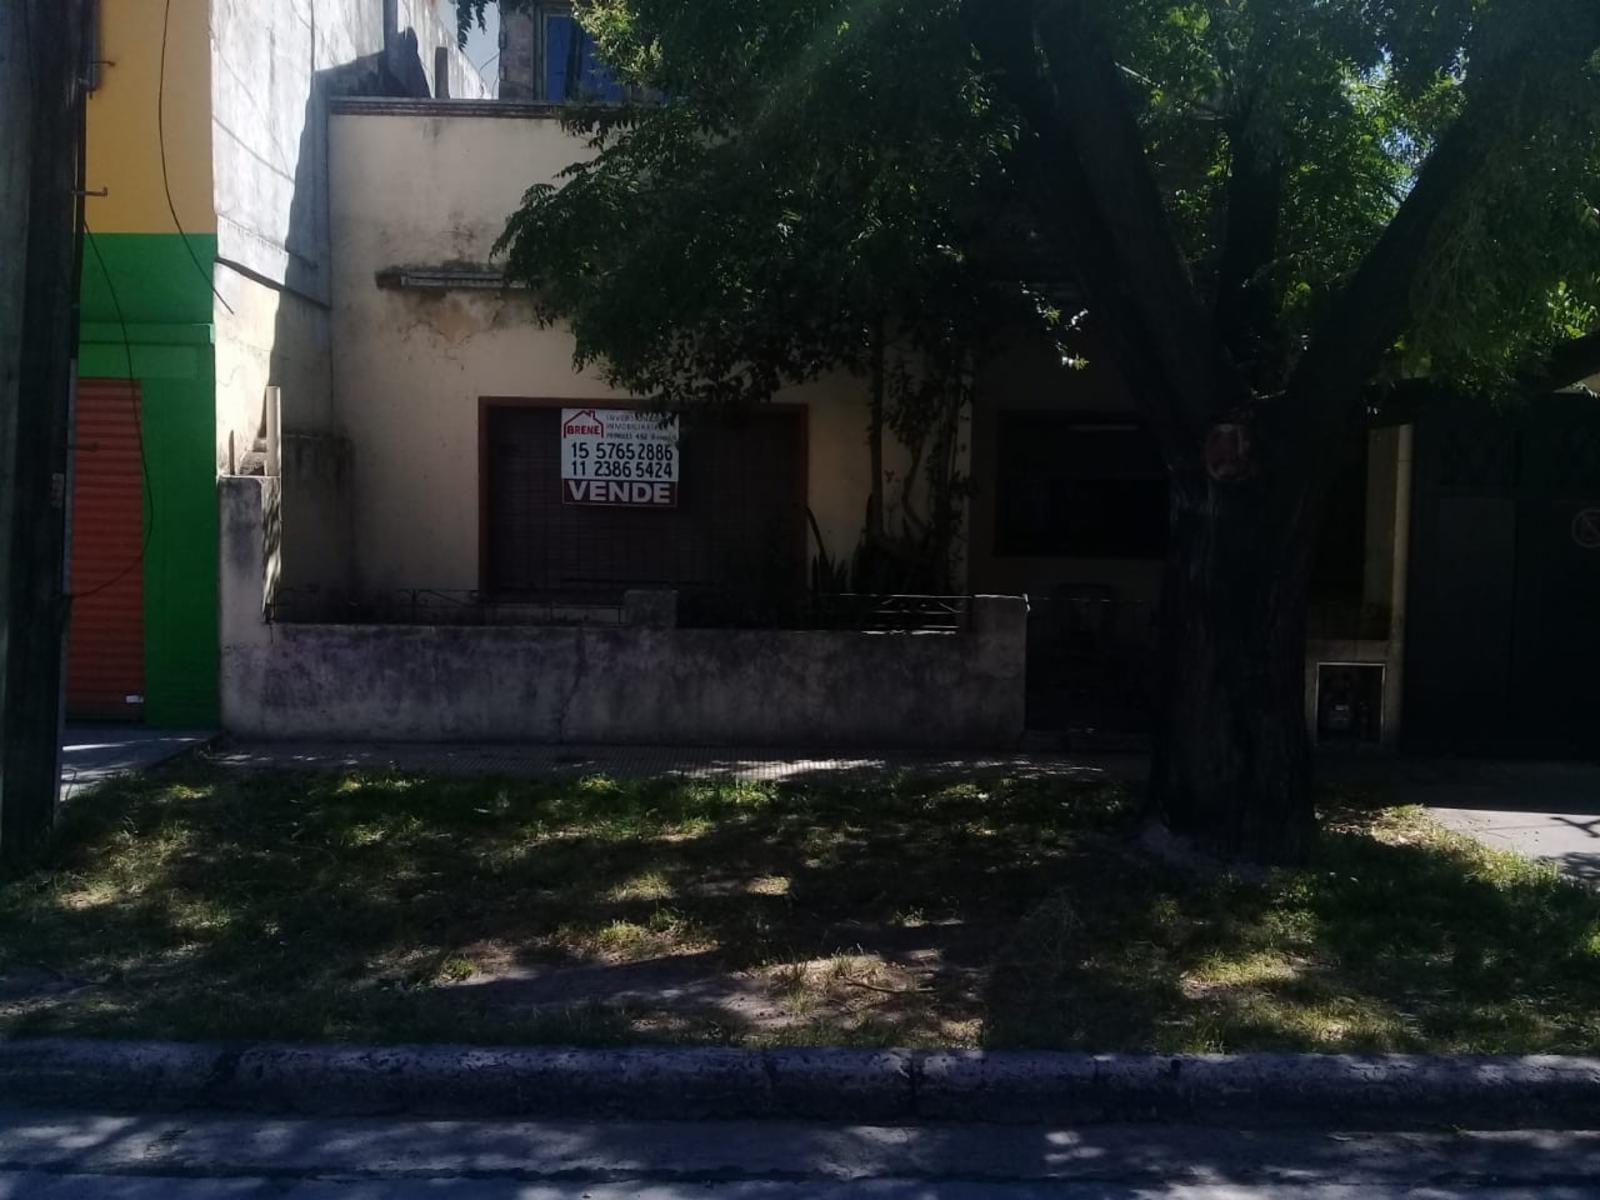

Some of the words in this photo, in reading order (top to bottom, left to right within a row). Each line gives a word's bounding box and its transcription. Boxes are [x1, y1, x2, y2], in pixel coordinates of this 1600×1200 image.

[567, 425, 600, 435] BRENE
[571, 442, 589, 459] 15
[596, 442, 635, 460] 5765
[638, 443, 673, 460] 2886
[572, 461, 586, 476] 11
[594, 461, 632, 478] 2386
[635, 462, 672, 478] 5424
[568, 480, 670, 503] VENDE
